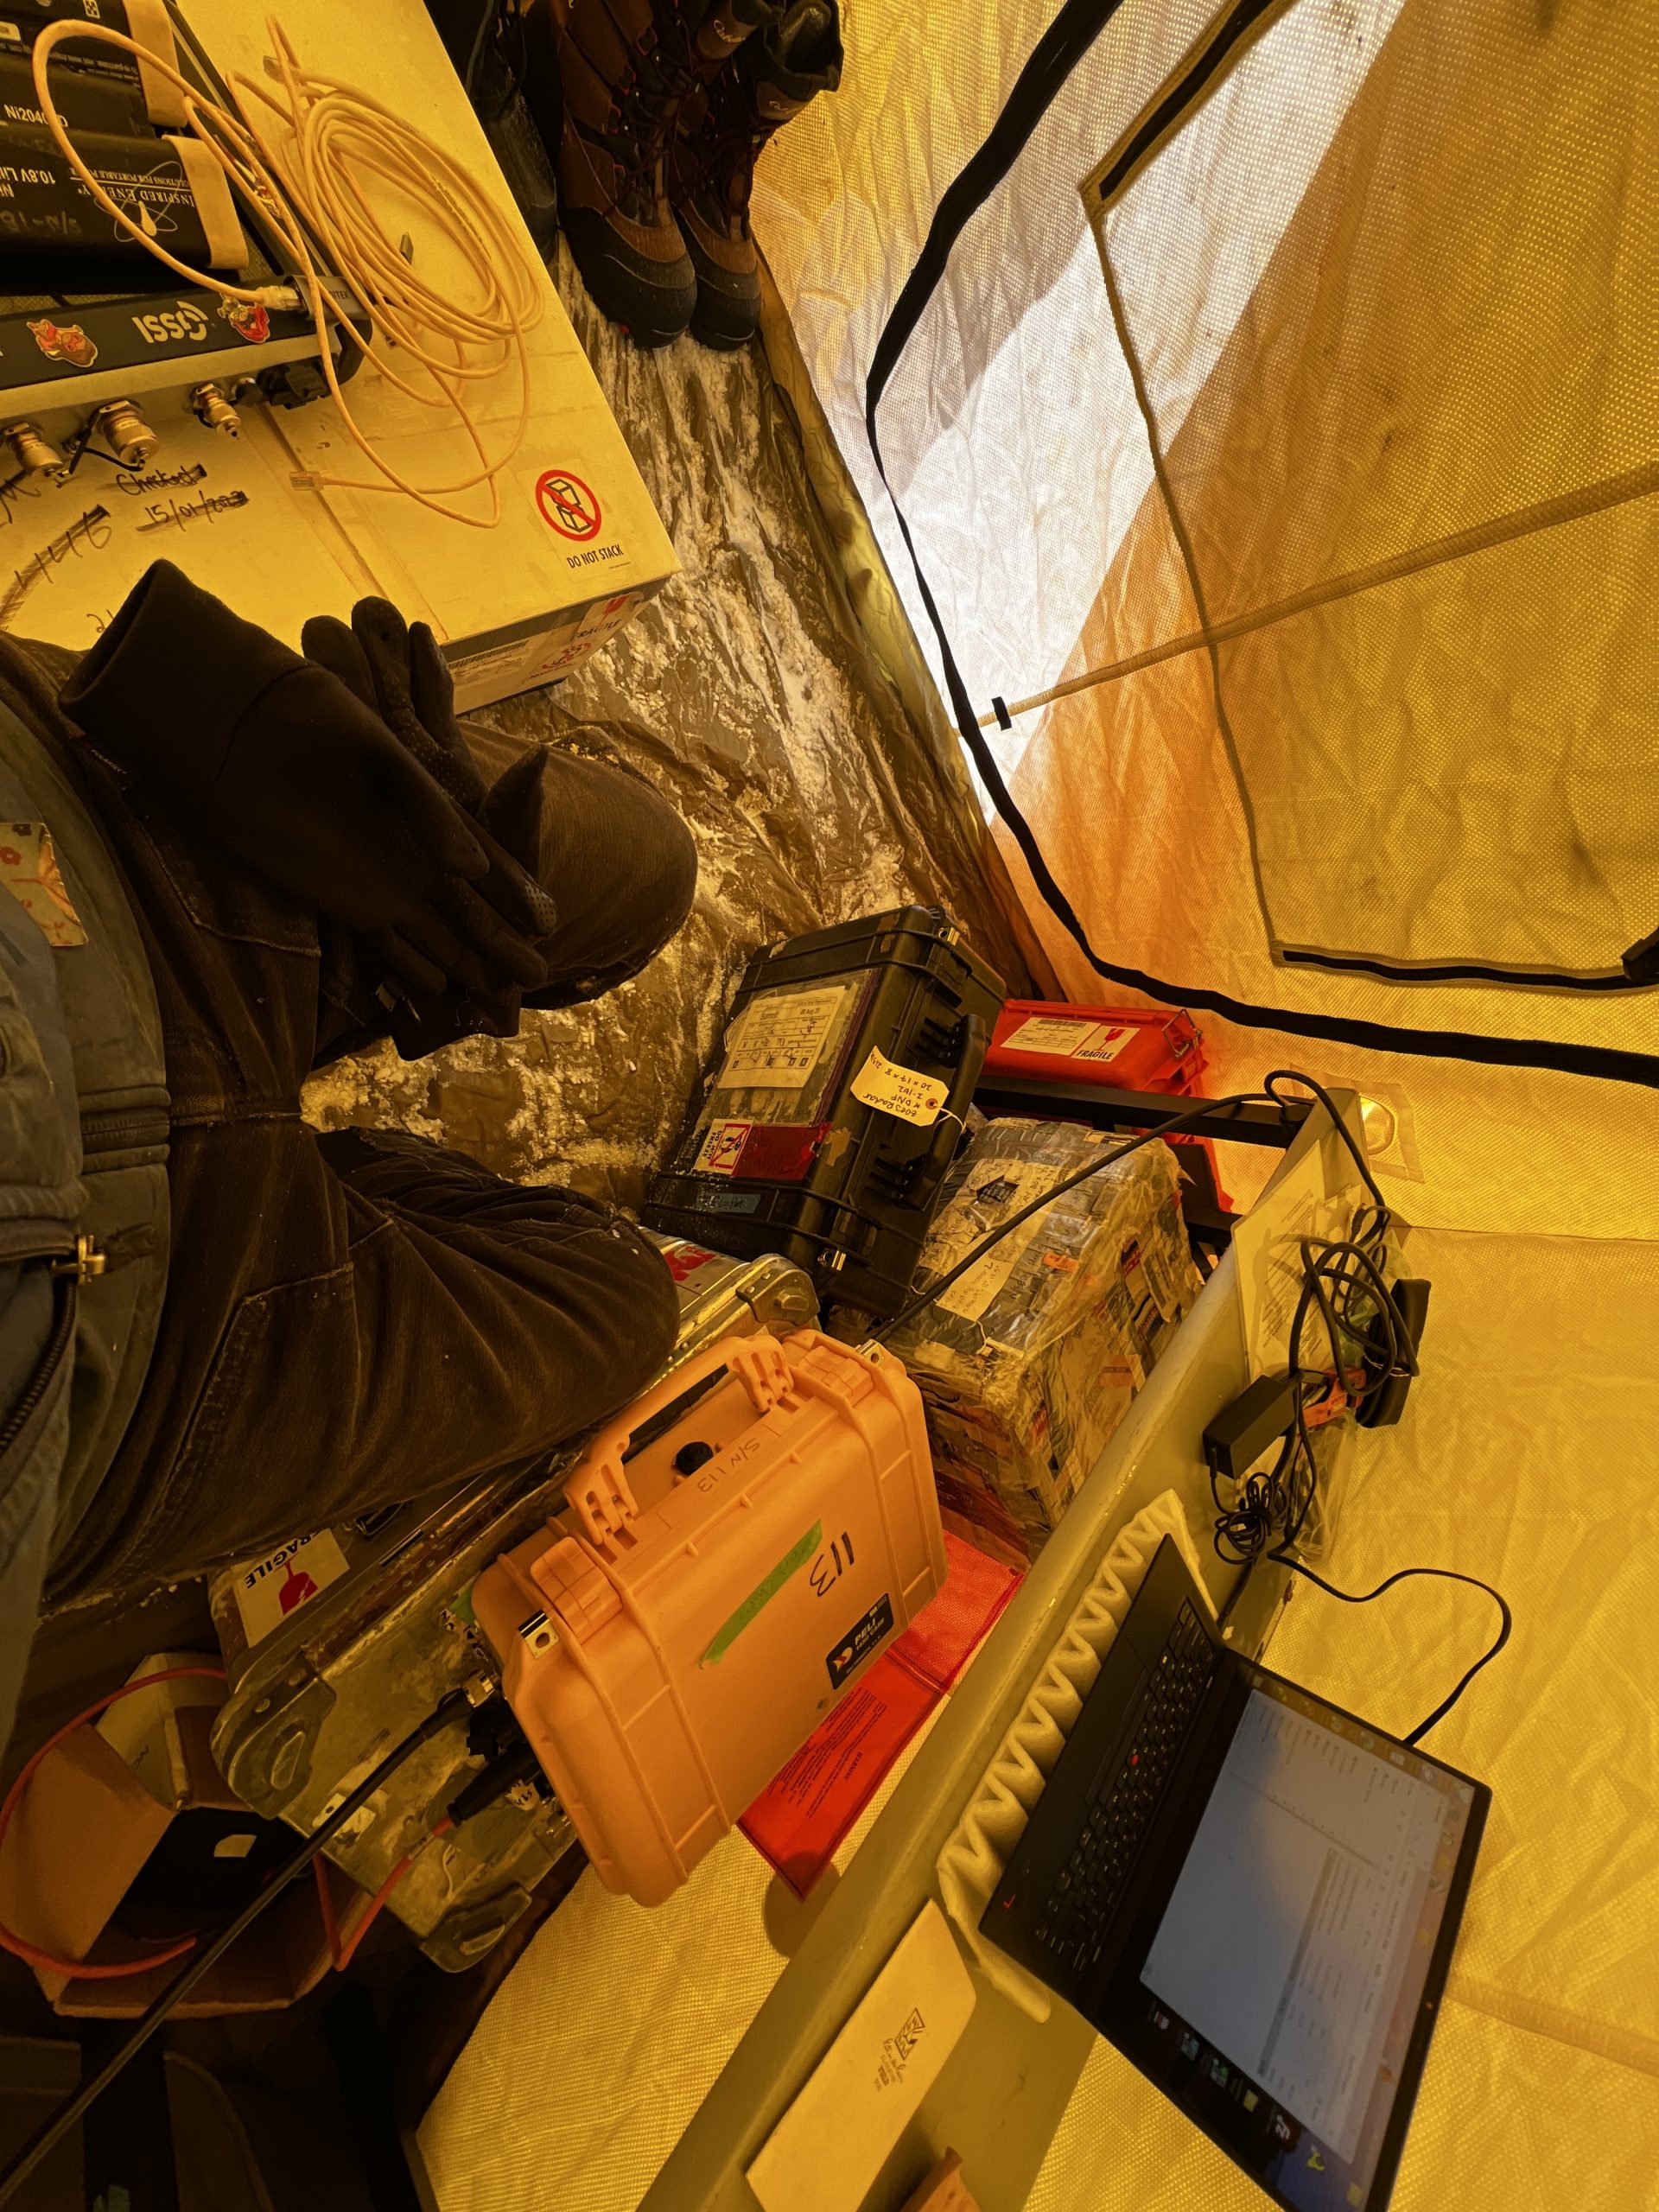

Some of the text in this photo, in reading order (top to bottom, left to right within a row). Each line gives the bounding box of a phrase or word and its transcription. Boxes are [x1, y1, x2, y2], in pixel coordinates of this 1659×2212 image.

[4, 105, 68, 128] Ni204D
[22, 168, 56, 185] 10.8V
[152, 176, 189, 188] OLUTIONS
[132, 300, 208, 344] GSSI
[567, 556, 582, 569] DO
[581, 550, 600, 566] NOT
[599, 544, 624, 560] STACK
[1077, 1049, 1115, 1060] FRAGILE
[900, 1075, 912, 1084] 17
[920, 1082, 932, 1092] 20
[862, 1092, 893, 1110] Radar
[891, 1094, 912, 1107] DNF
[715, 1130, 723, 1141] DO
[696, 1437, 761, 1493] S/N 113
[244, 1530, 321, 1590] RAGILE
[810, 1531, 855, 1598] 113
[855, 1618, 876, 1646] PELI
[843, 1751, 864, 1781] WARNING
